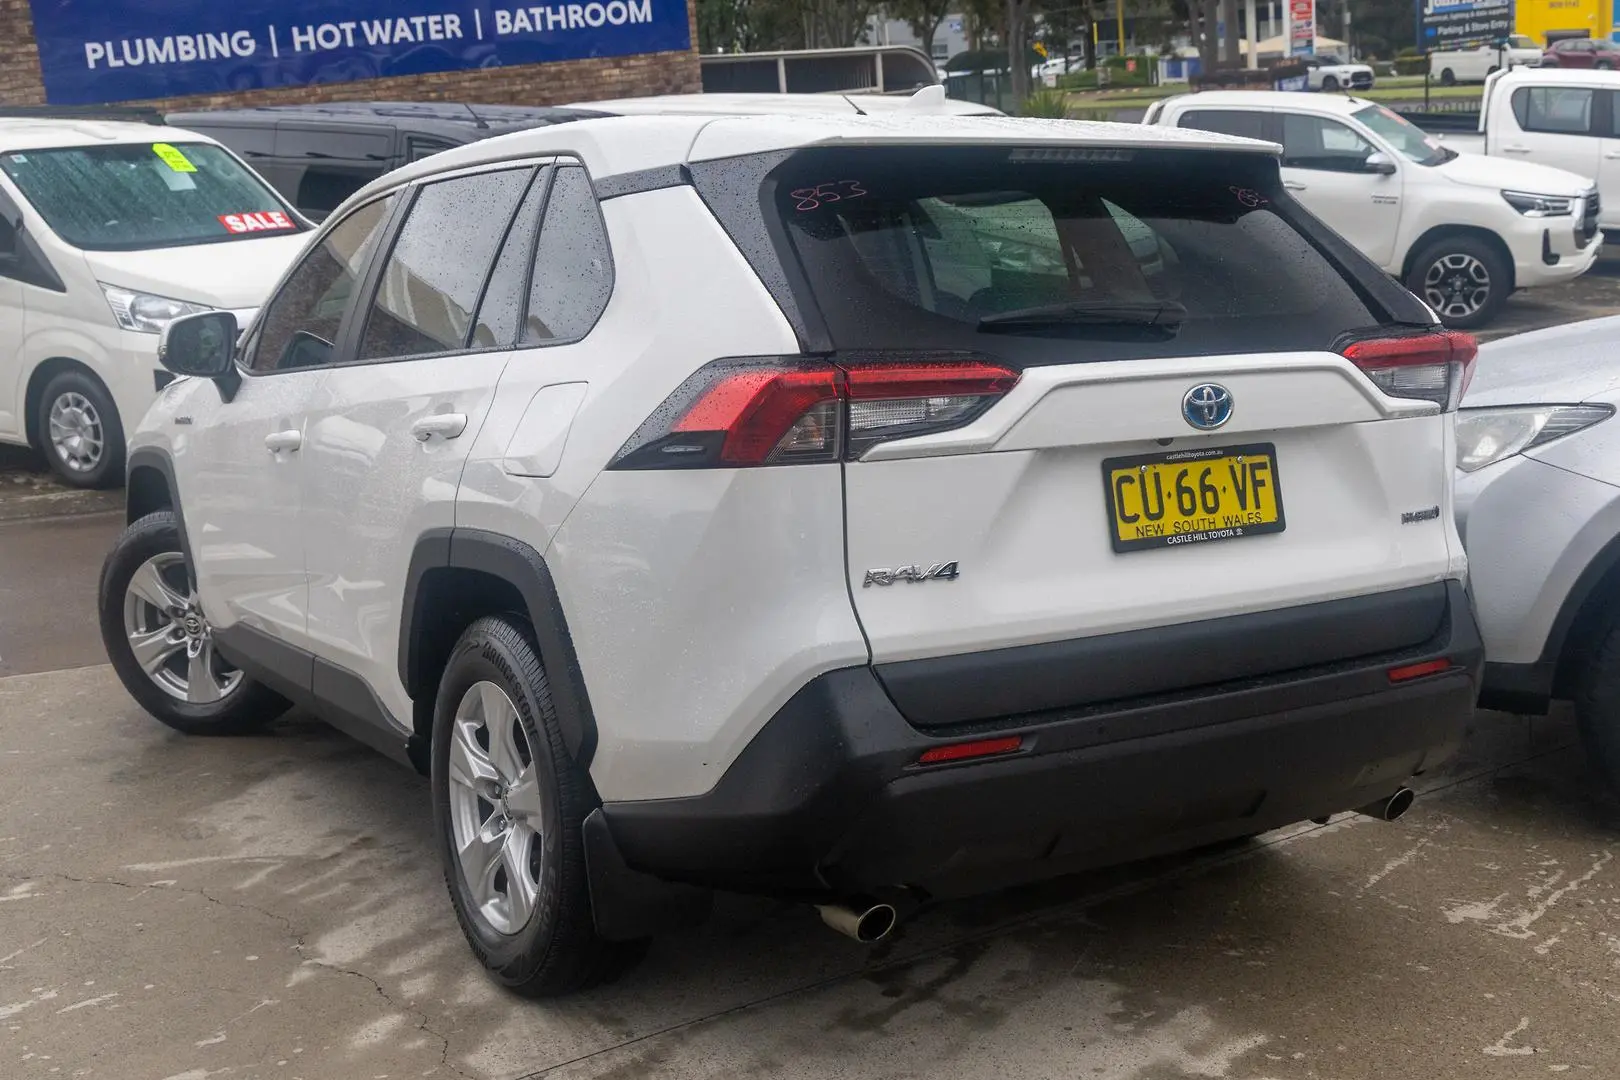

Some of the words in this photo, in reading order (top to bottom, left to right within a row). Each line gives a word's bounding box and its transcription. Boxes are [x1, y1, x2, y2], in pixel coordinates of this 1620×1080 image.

[84, 30, 256, 69] PLUMBING
[292, 22, 357, 52] HOT
[360, 14, 463, 46] WATER
[495, 0, 652, 35] BATHROOM
[1437, 25, 1464, 36] Parking
[1465, 24, 1470, 32] &
[1471, 22, 1489, 31] Store
[1491, 20, 1509, 29] Entry
[790, 180, 868, 211] 853
[224, 211, 291, 233] SALE
[1166, 450, 1224, 461] castlehilltoyota.com.au
[1136, 523, 1165, 538] NEW
[1173, 517, 1216, 534] SOUTH
[1223, 511, 1263, 527] WALES
[1166, 532, 1192, 545] CASTLE
[1193, 531, 1207, 542] HILL
[1208, 529, 1234, 540] TOYOTA
[862, 560, 959, 589] RAV4
